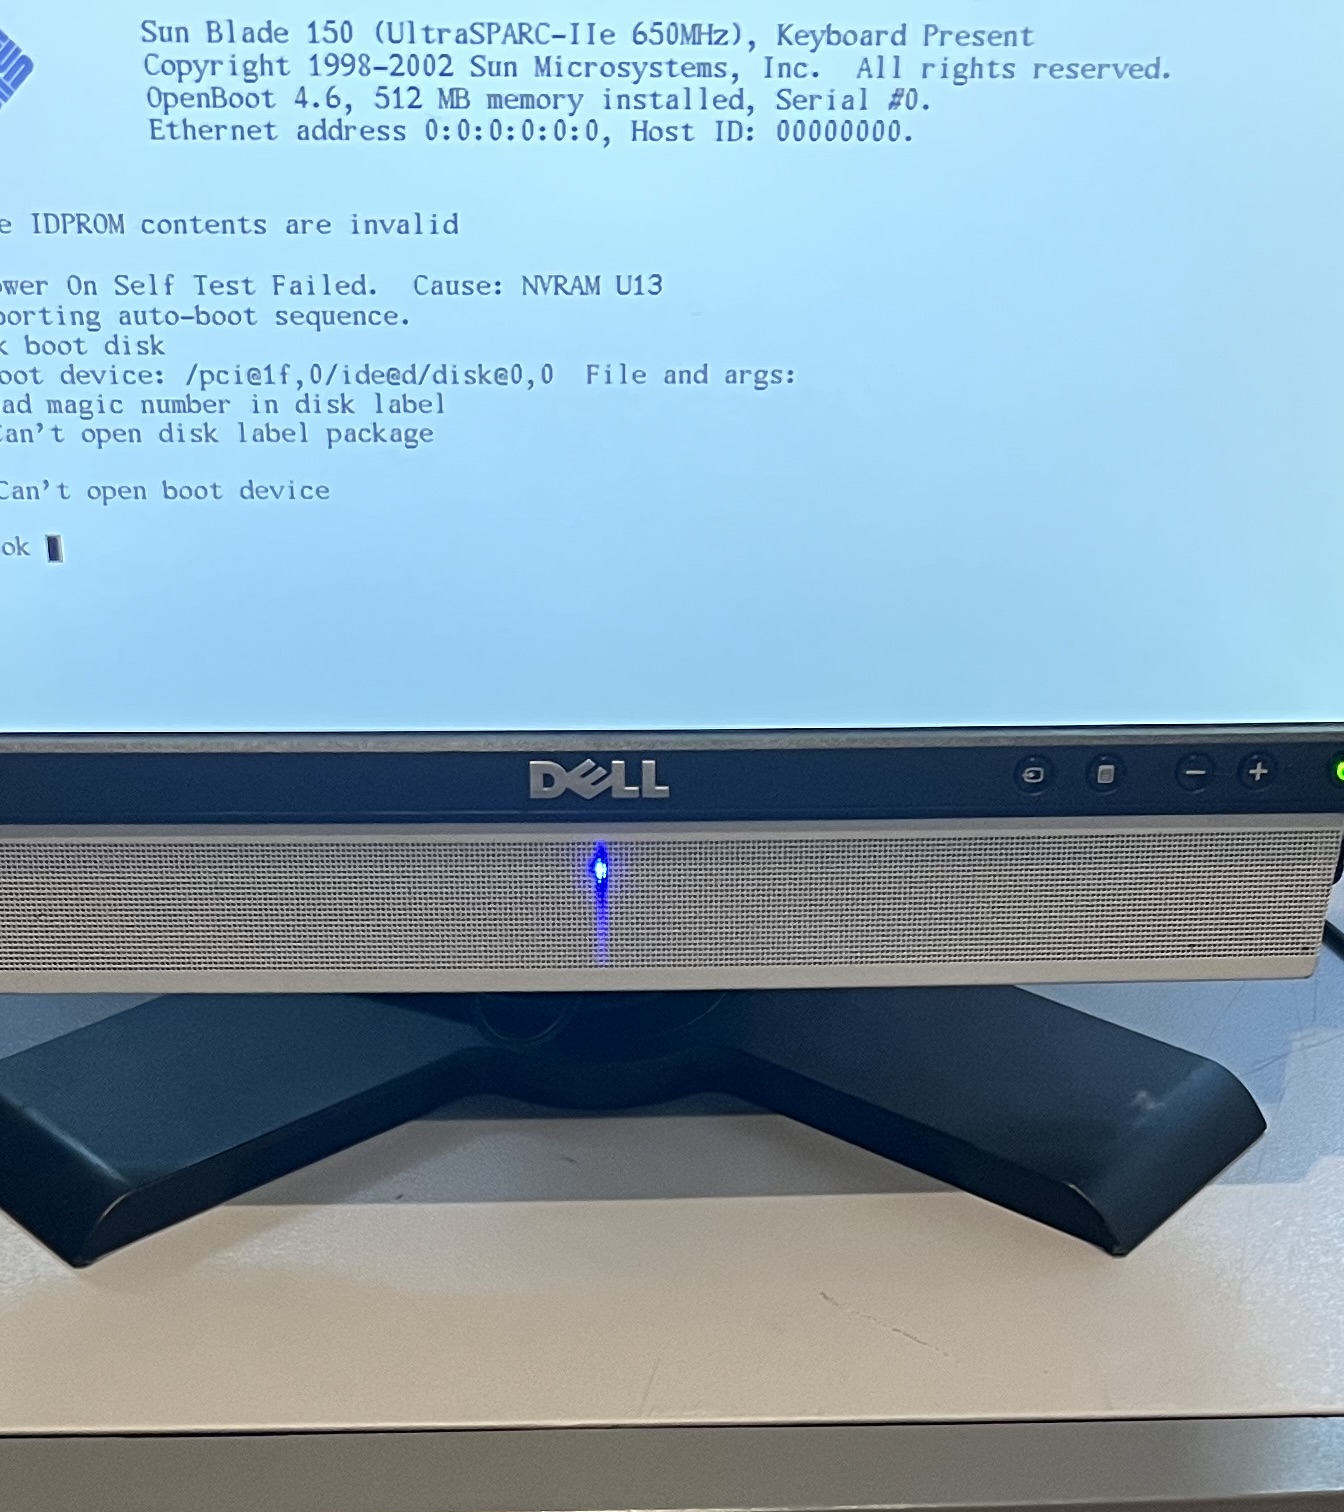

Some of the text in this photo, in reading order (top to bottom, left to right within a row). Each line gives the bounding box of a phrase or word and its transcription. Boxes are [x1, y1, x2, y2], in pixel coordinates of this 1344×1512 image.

[140, 18, 1035, 54] Sun Blade 150 (UltraSPARC-IIe 650MHz), Keyboard Present
[143, 52, 1171, 87] Copyright 1998-2002 Sun Microsystems, Inc. All rights reserved.
[146, 84, 930, 118] OpenBoot 4.6, 512 MB memory installed, Serial #0.
[147, 117, 913, 149] Ethernet address 0:0:0:0:0:0, Host ID: 00000000.
[29, 212, 125, 235] IDPROM
[140, 215, 267, 235] contents
[285, 218, 332, 235] are
[351, 211, 459, 235] invalid
[66, 274, 98, 296] On
[113, 273, 175, 296] Self
[192, 274, 257, 296] Test
[271, 273, 377, 296] Failed.
[412, 274, 502, 296] Cause:
[521, 274, 602, 297] NVRAM
[615, 273, 663, 296] U13
[118, 303, 258, 326] auto-boot
[275, 309, 409, 333] sequence.
[23, 333, 89, 356] boot
[104, 333, 166, 356] disk
[59, 362, 164, 386] device:
[586, 362, 647, 385] File
[663, 362, 709, 385] and
[724, 368, 795, 391] args:
[44, 393, 124, 421] magic
[140, 392, 232, 415] number
[251, 393, 280, 415] in
[294, 392, 356, 415] disk
[373, 391, 445, 415] label
[81, 427, 143, 450] open
[158, 421, 220, 444] disk
[237, 421, 309, 444] label
[325, 421, 434, 450] package
[86, 485, 148, 507] open
[161, 479, 224, 500] boot
[239, 479, 330, 501] device
[1, 535, 32, 557] ok
[528, 758, 671, 800] DELL
